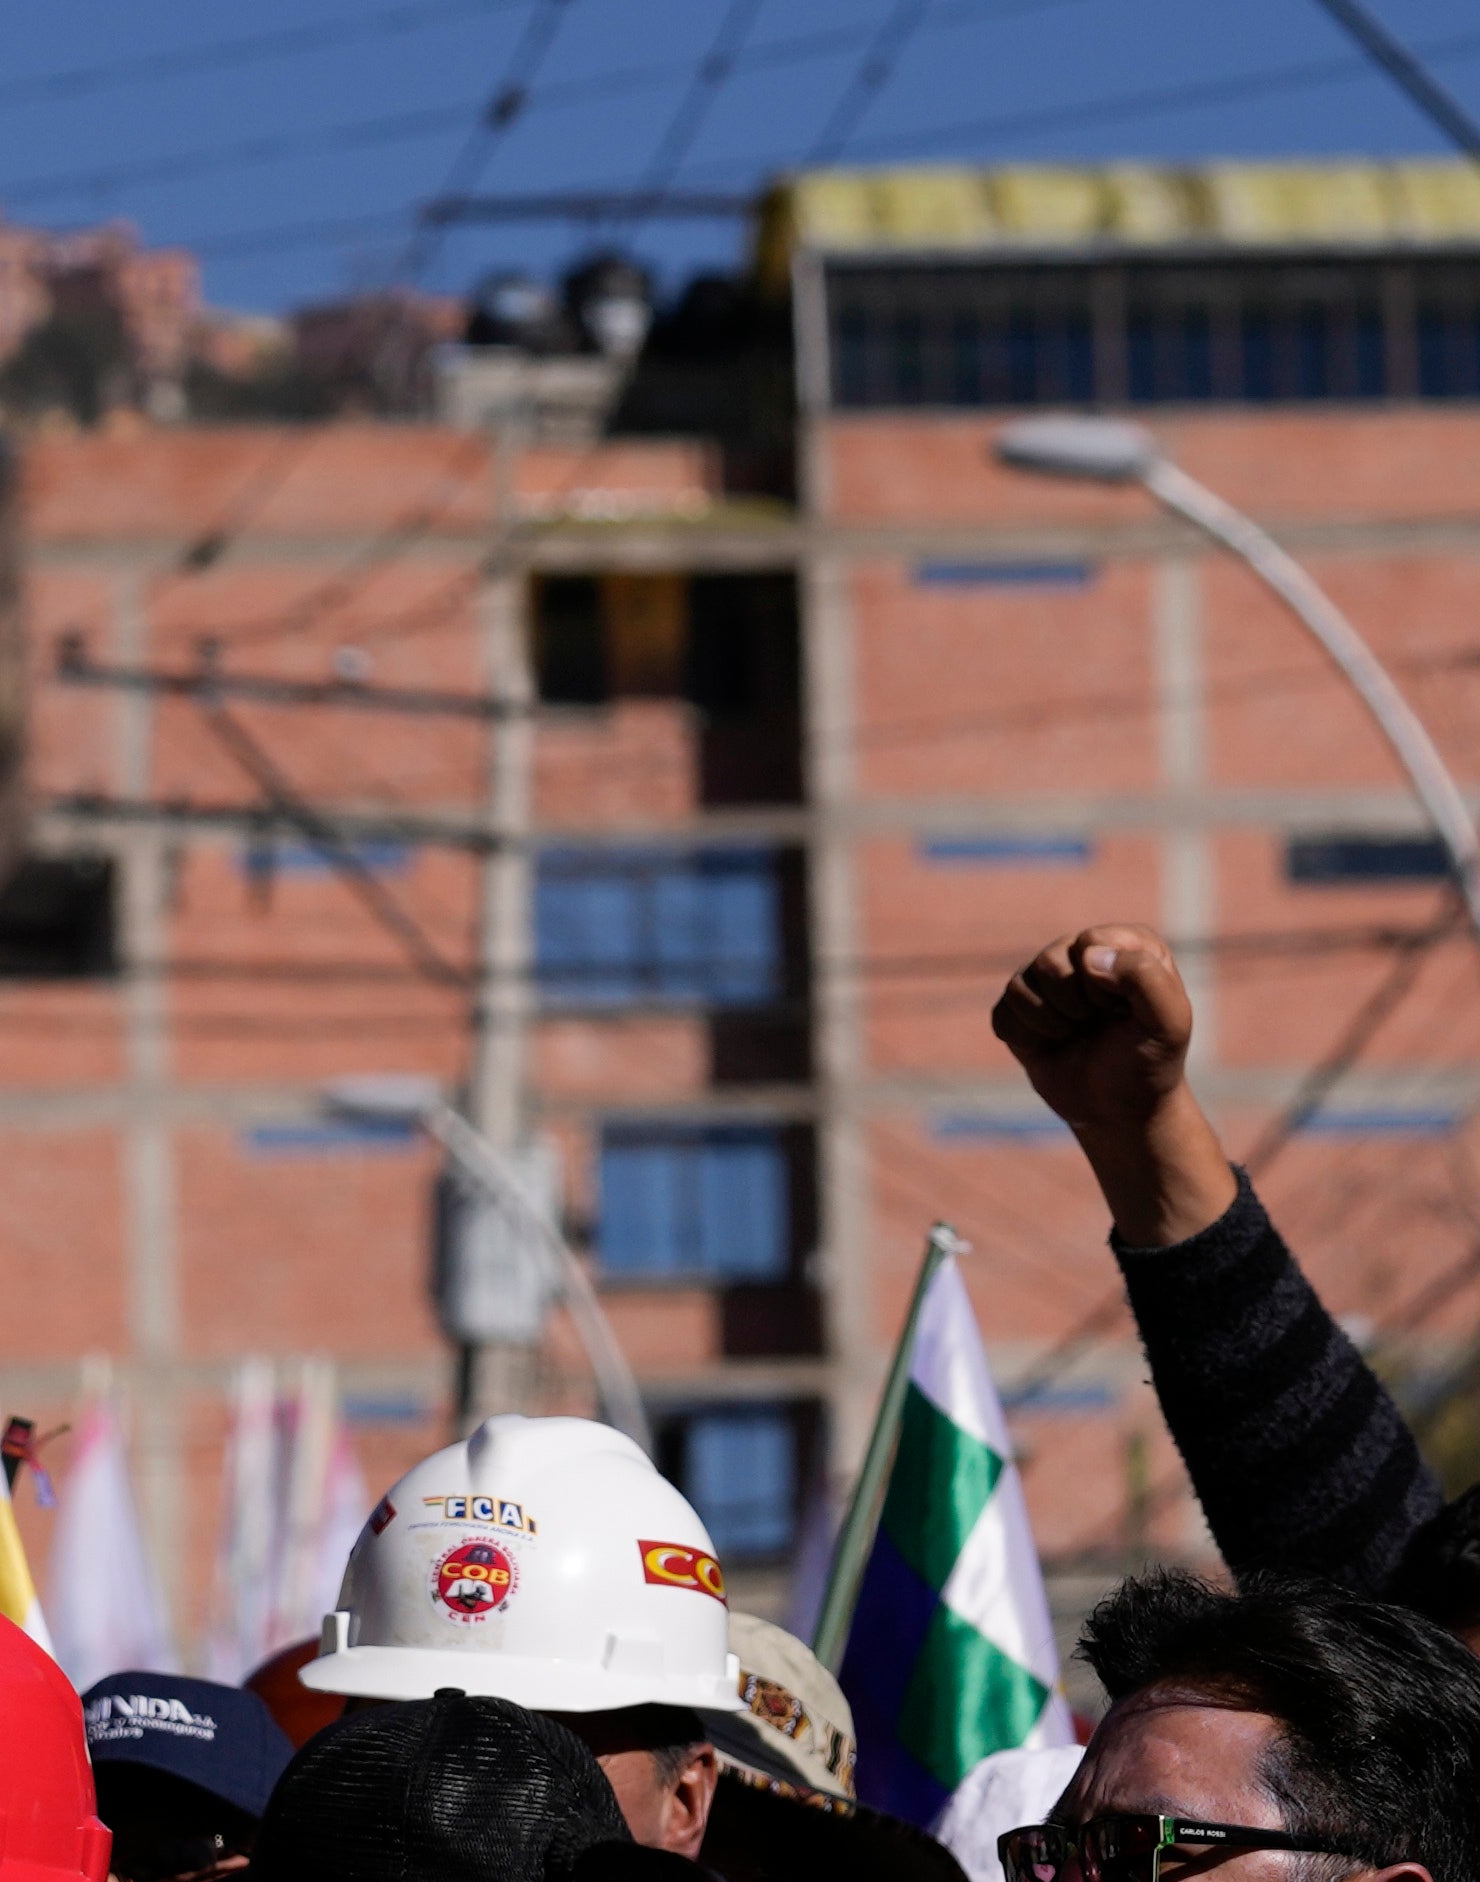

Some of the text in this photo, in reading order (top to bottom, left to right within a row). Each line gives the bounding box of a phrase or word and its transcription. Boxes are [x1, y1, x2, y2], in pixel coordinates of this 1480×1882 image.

[446, 1496, 524, 1529] FCA
[441, 1562, 510, 1585] COB
[448, 1611, 486, 1623] CEN
[1179, 1827, 1205, 1836] CARLOS
